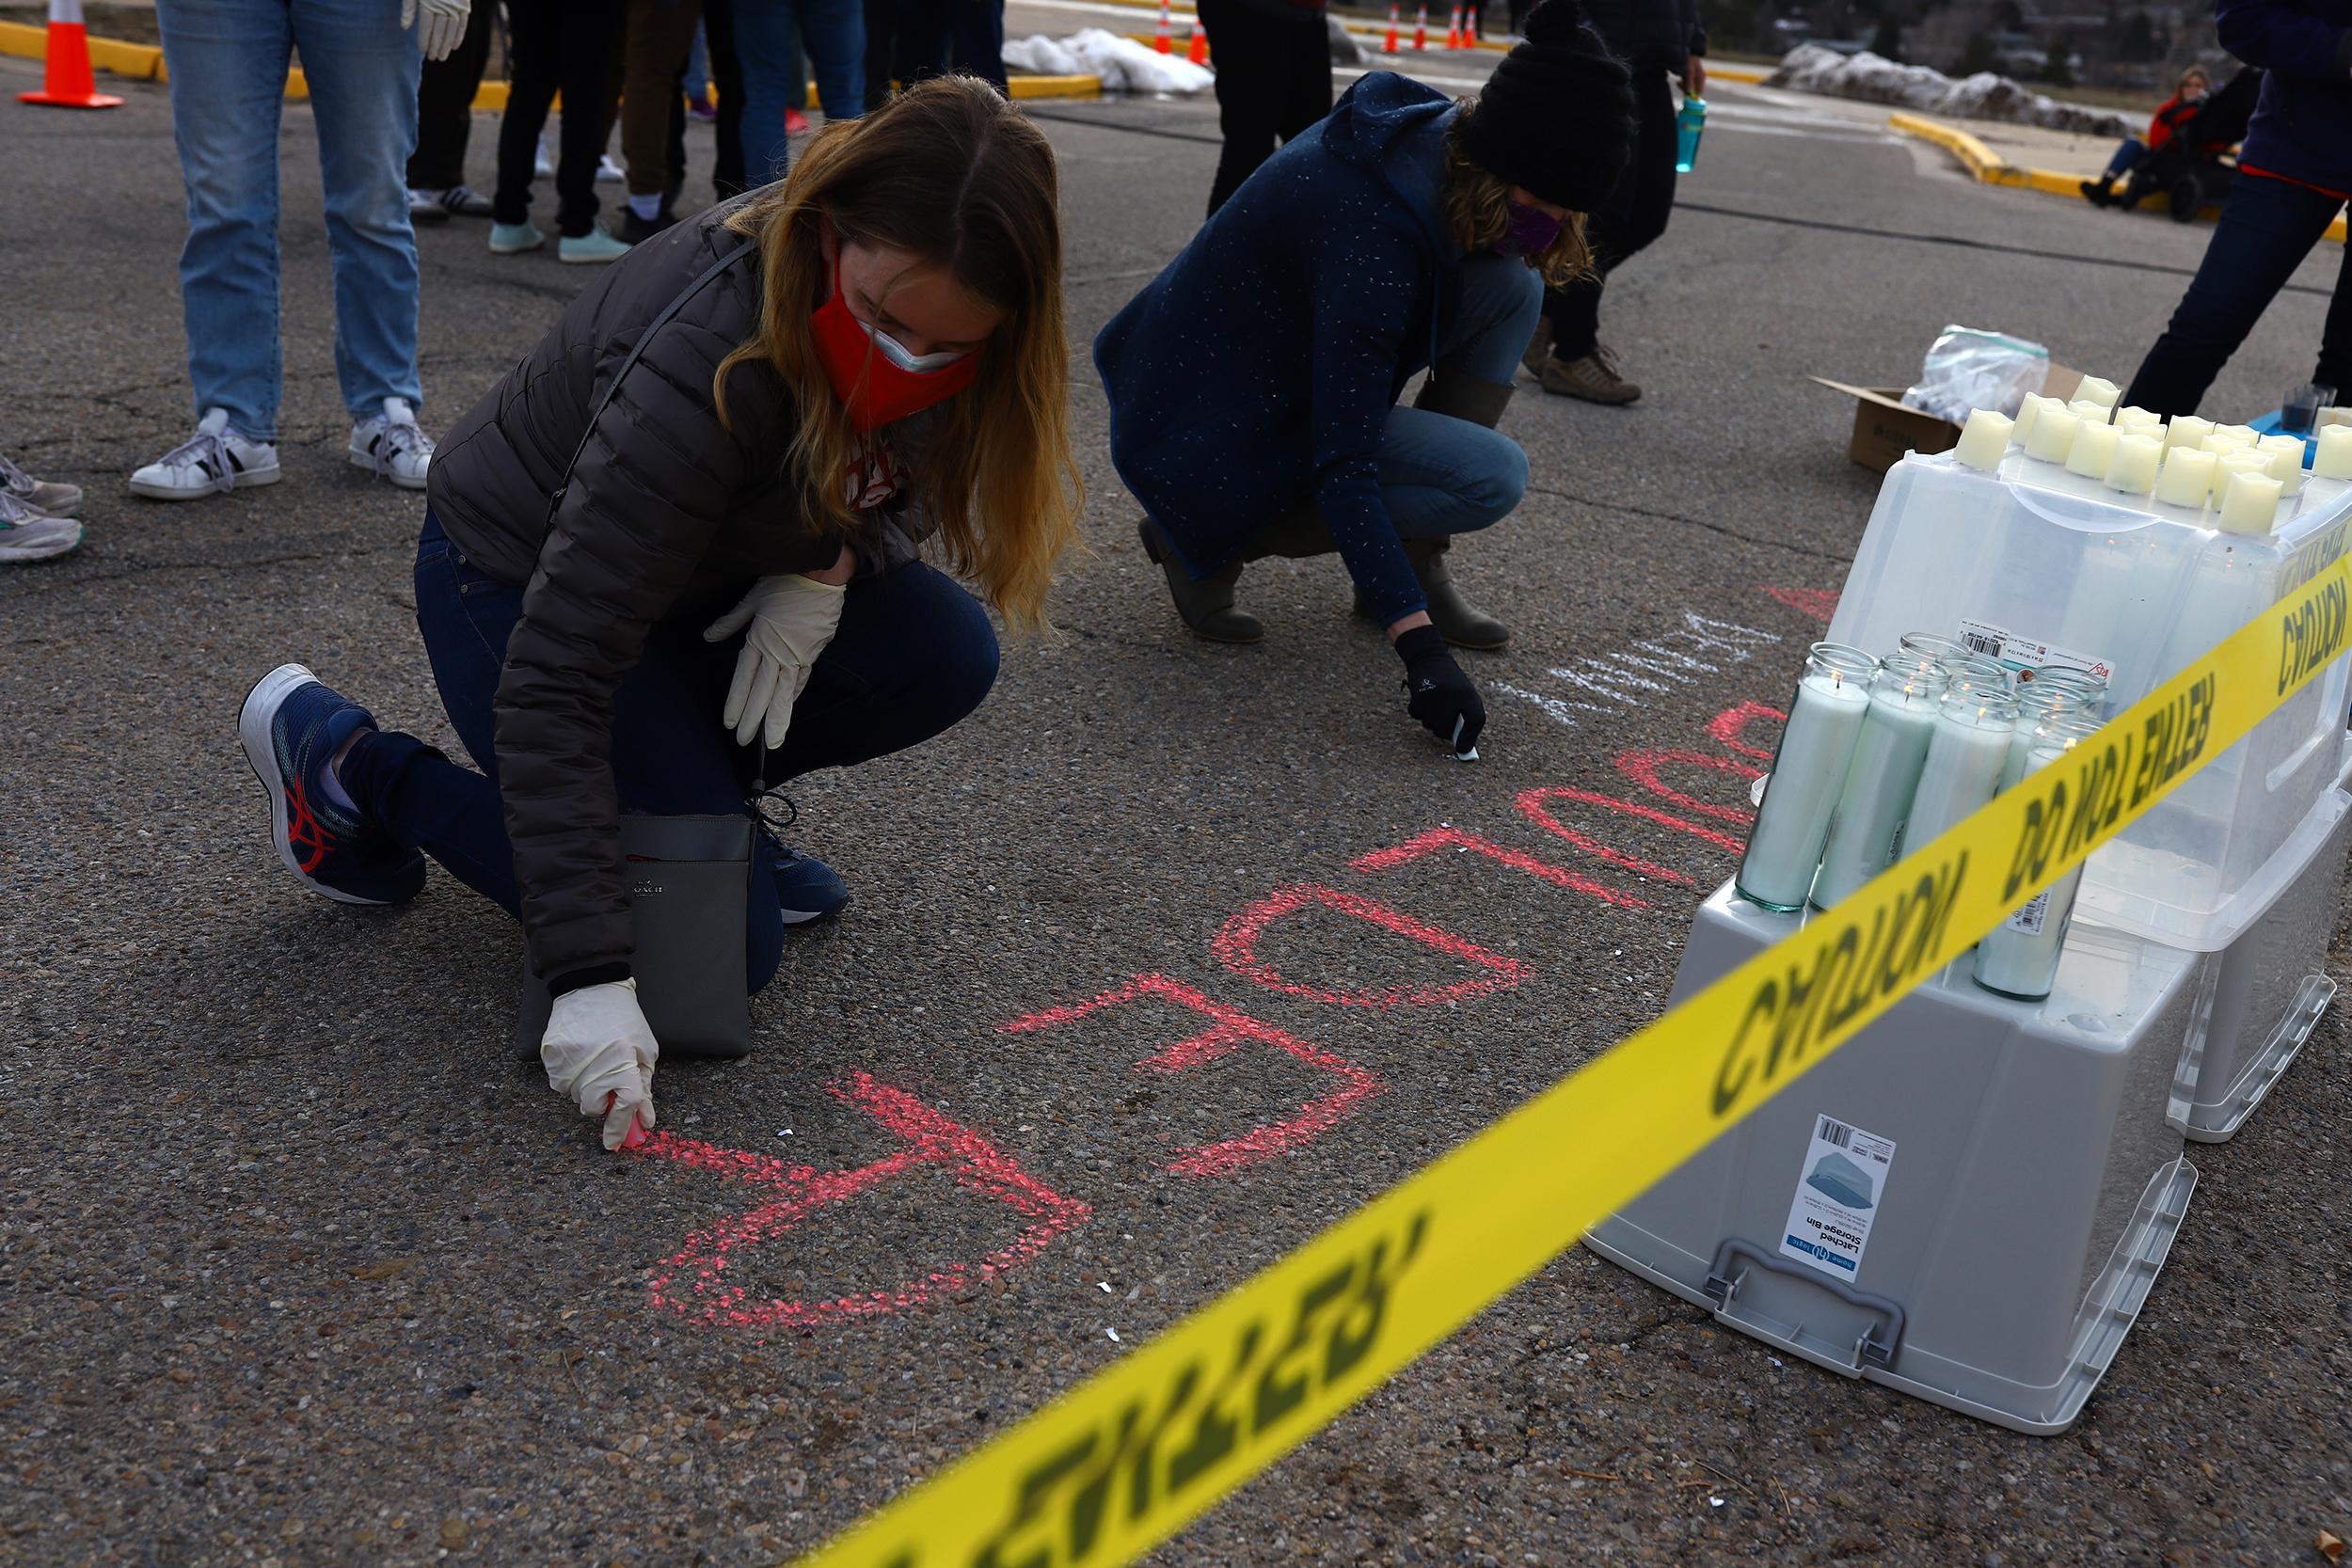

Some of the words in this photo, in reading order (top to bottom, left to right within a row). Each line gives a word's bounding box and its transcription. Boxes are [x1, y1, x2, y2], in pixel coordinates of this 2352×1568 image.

[1806, 1216, 1822, 1229] Bin
[1820, 1232, 1859, 1254] Latched
[1824, 1224, 1862, 1245] Storage
